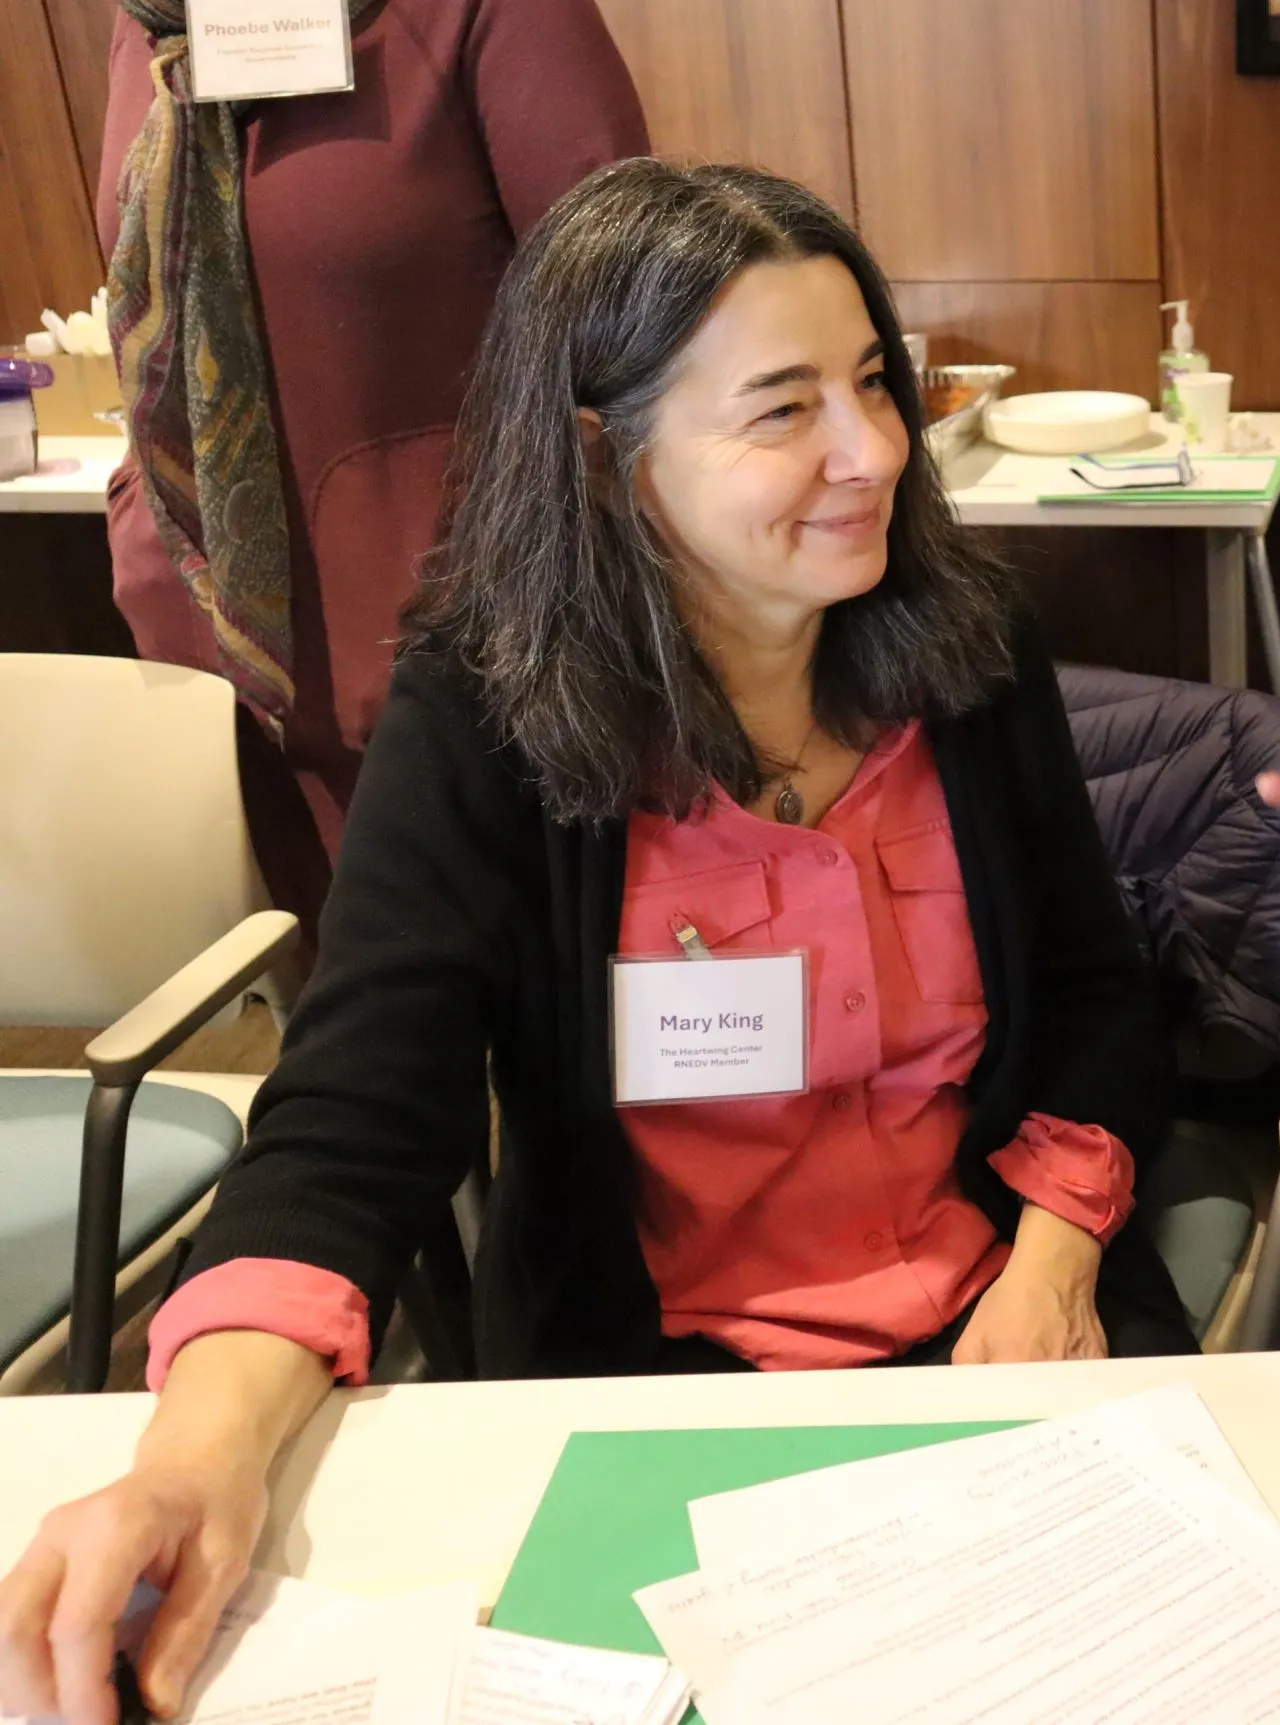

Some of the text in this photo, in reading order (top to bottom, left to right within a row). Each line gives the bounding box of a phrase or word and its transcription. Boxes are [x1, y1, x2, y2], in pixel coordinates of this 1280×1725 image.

[204, 17, 332, 36] Phoebe Walker
[660, 1011, 764, 1033] Mary King
[660, 1045, 763, 1057] The Heartwing Center
[674, 1057, 750, 1068] RNEDV Member
